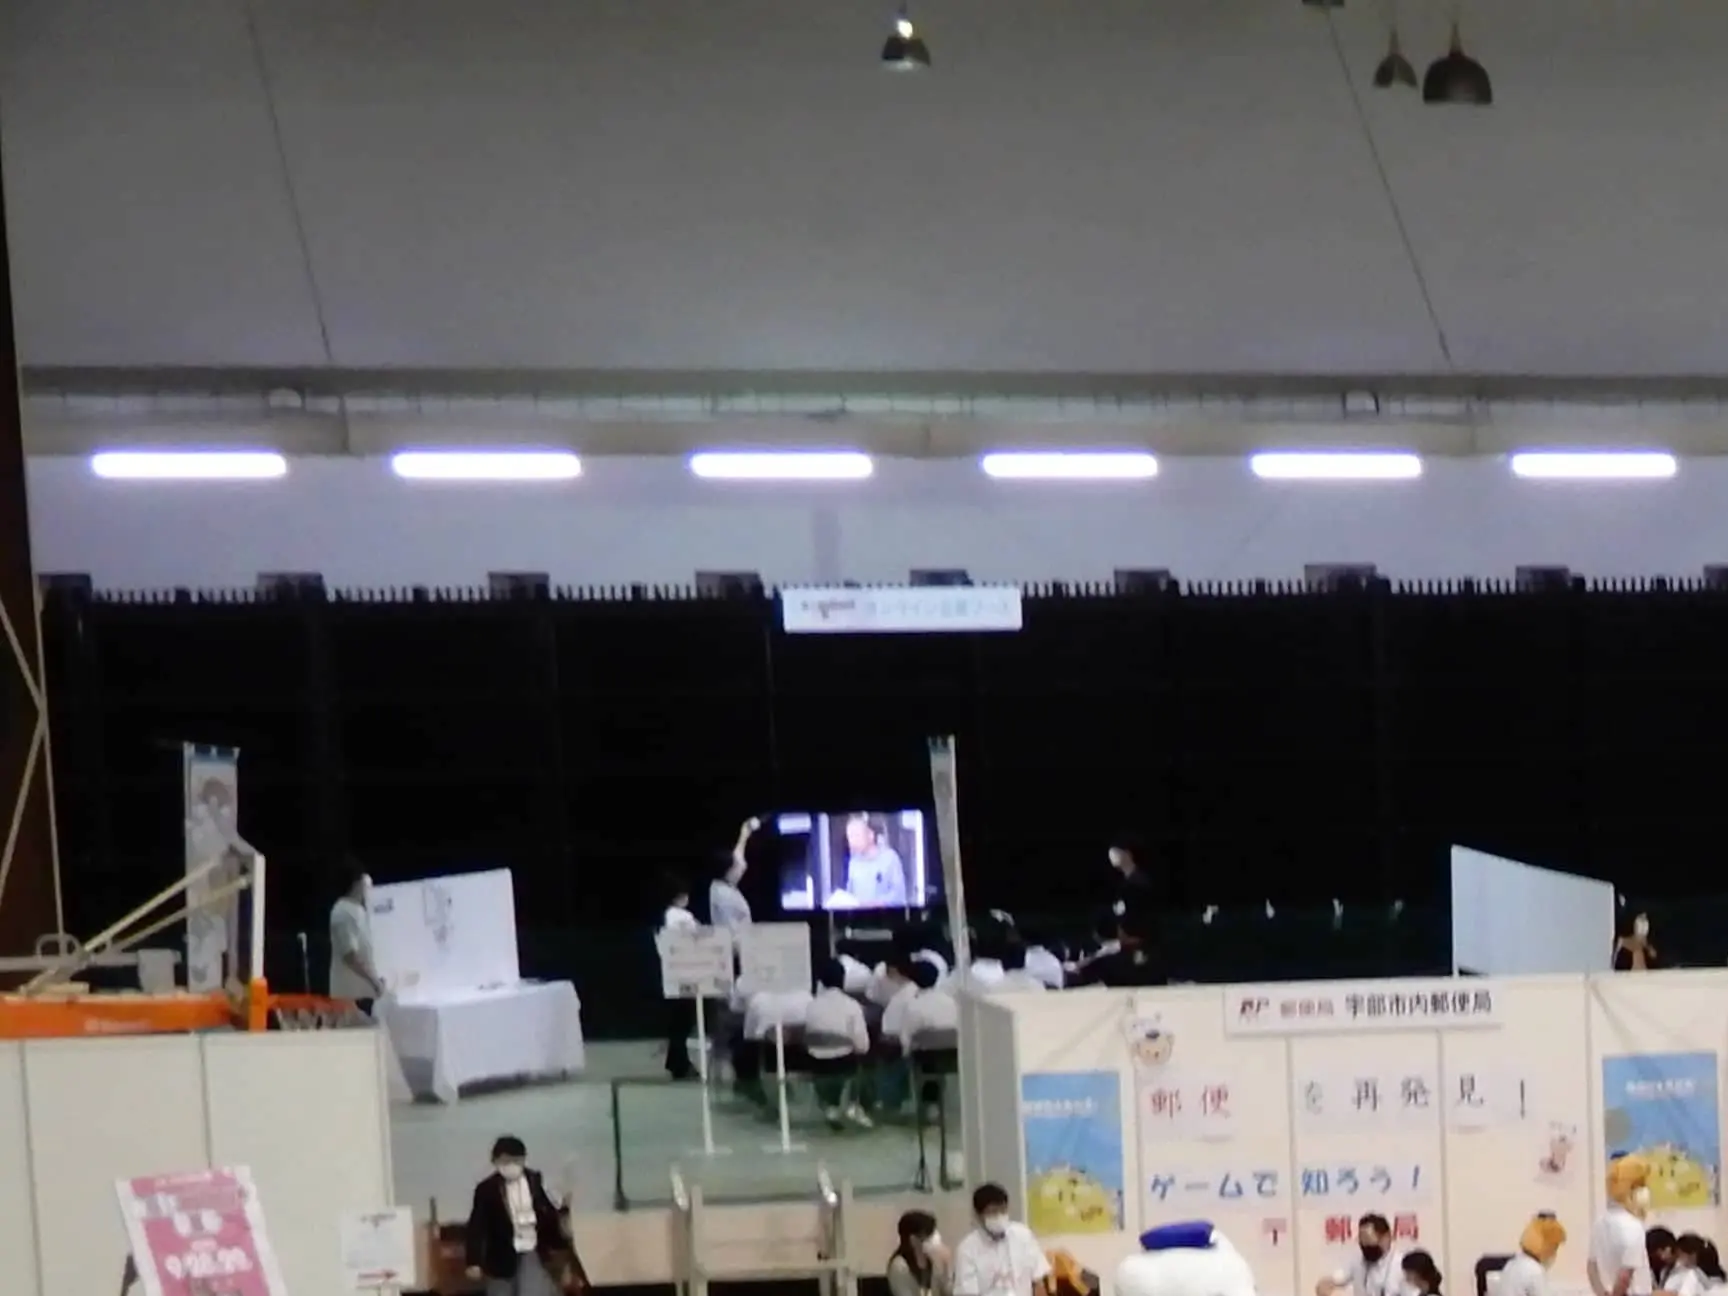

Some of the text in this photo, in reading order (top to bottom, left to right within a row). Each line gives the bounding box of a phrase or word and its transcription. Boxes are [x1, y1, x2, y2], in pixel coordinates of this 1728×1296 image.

[1345, 989, 1493, 1021] 宇部市内郵便局
[1323, 1212, 1420, 1245] 郵局
